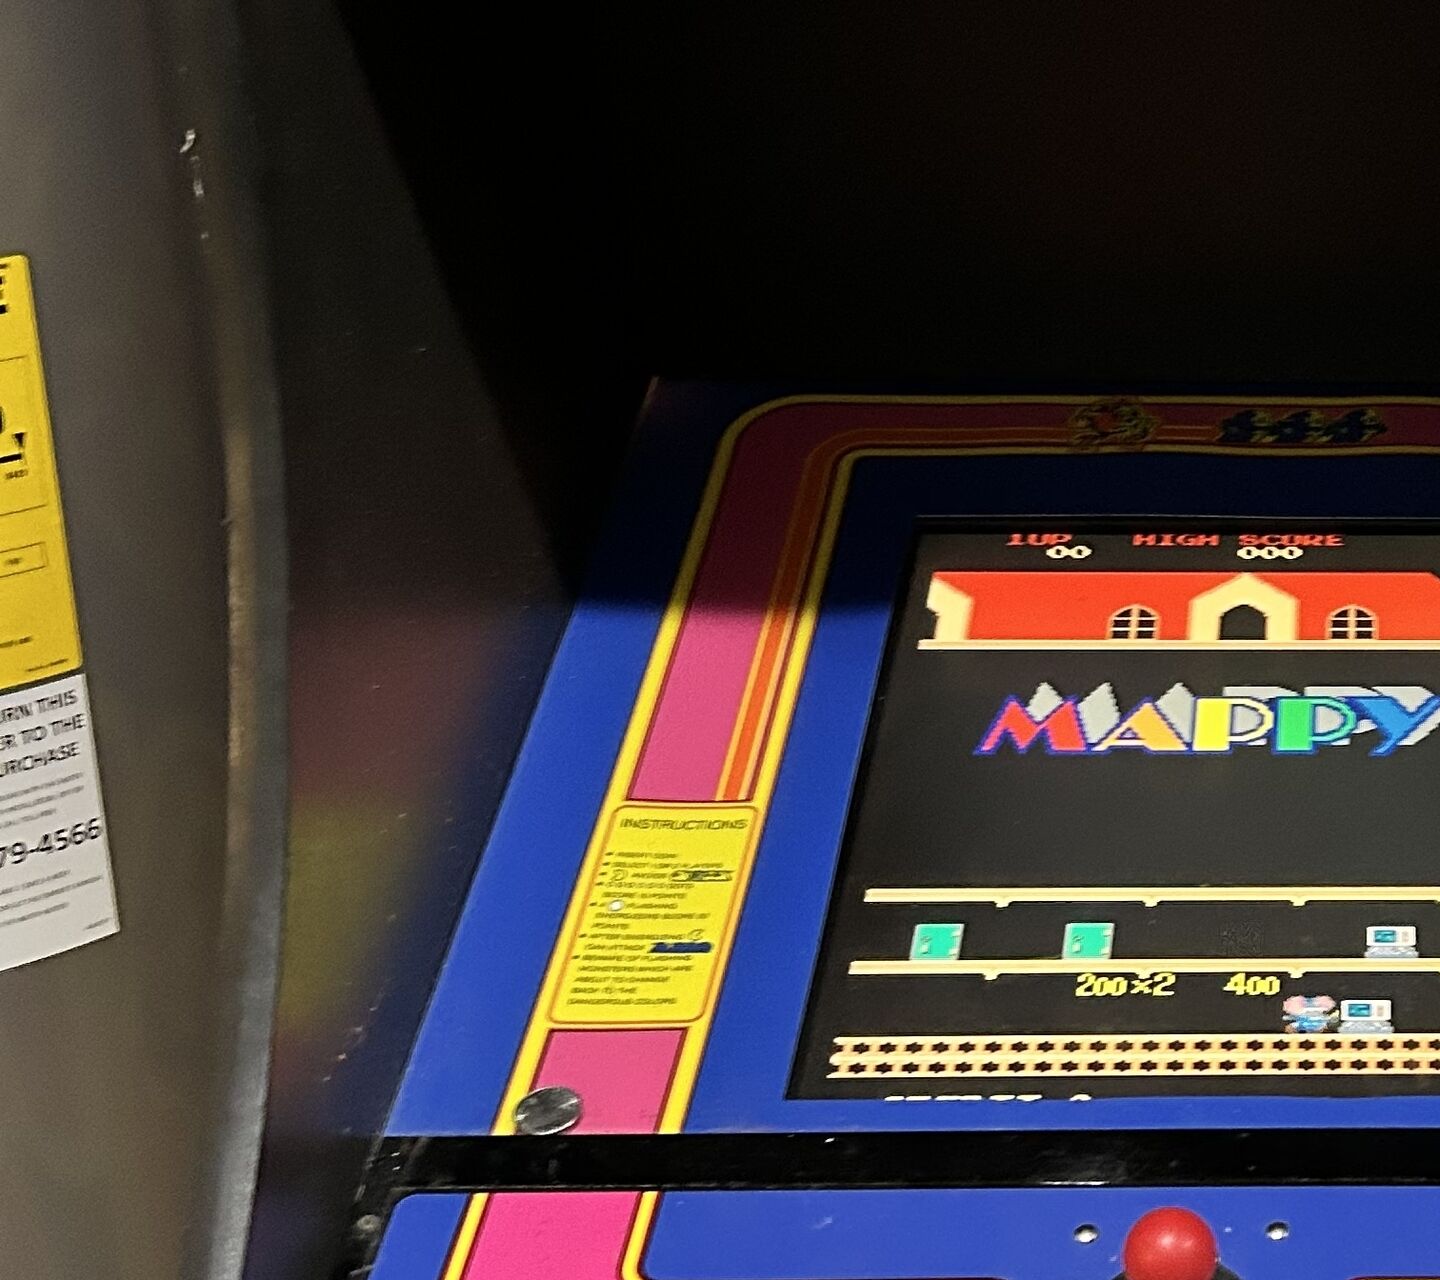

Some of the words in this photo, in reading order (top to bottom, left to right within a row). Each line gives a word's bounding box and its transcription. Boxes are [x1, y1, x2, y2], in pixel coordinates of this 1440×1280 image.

[1006, 533, 1074, 547] 1UP
[1131, 533, 1221, 547] HIGH
[1237, 533, 1346, 547] SCORE
[1045, 545, 1093, 560] 00
[35, 688, 79, 713] THIS
[20, 726, 48, 746] TO
[49, 713, 87, 739] THE
[619, 818, 749, 831] INSTRUCTIONS
[1222, 971, 1282, 997] 400
